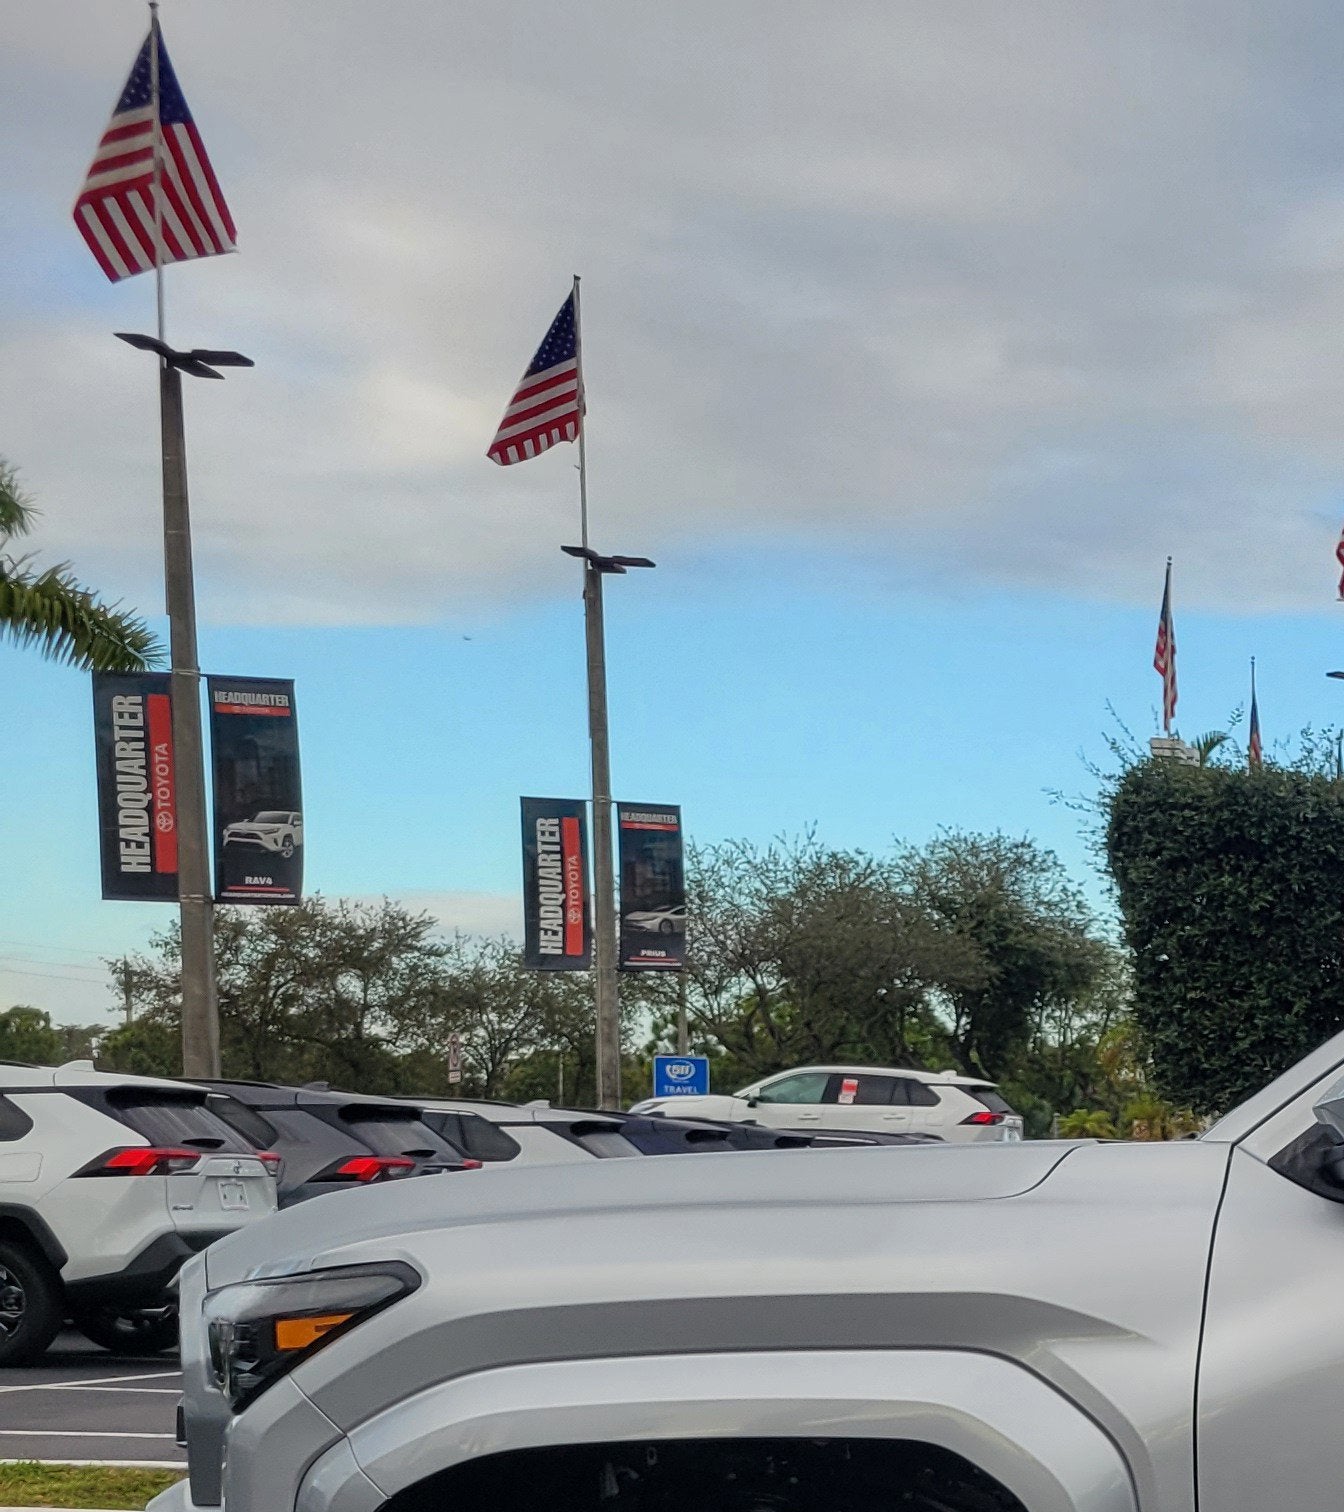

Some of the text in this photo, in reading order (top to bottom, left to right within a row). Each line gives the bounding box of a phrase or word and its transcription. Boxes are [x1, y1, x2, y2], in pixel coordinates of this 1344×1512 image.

[214, 690, 290, 707] HEADQUARTER
[112, 695, 153, 873] HEADQUARTER
[155, 743, 171, 809] TOYOTA
[244, 876, 273, 885] RAV4
[536, 817, 566, 955] HEADQUARTER
[568, 855, 580, 905] TOYOTA
[664, 1085, 700, 1095] TRAVEL
